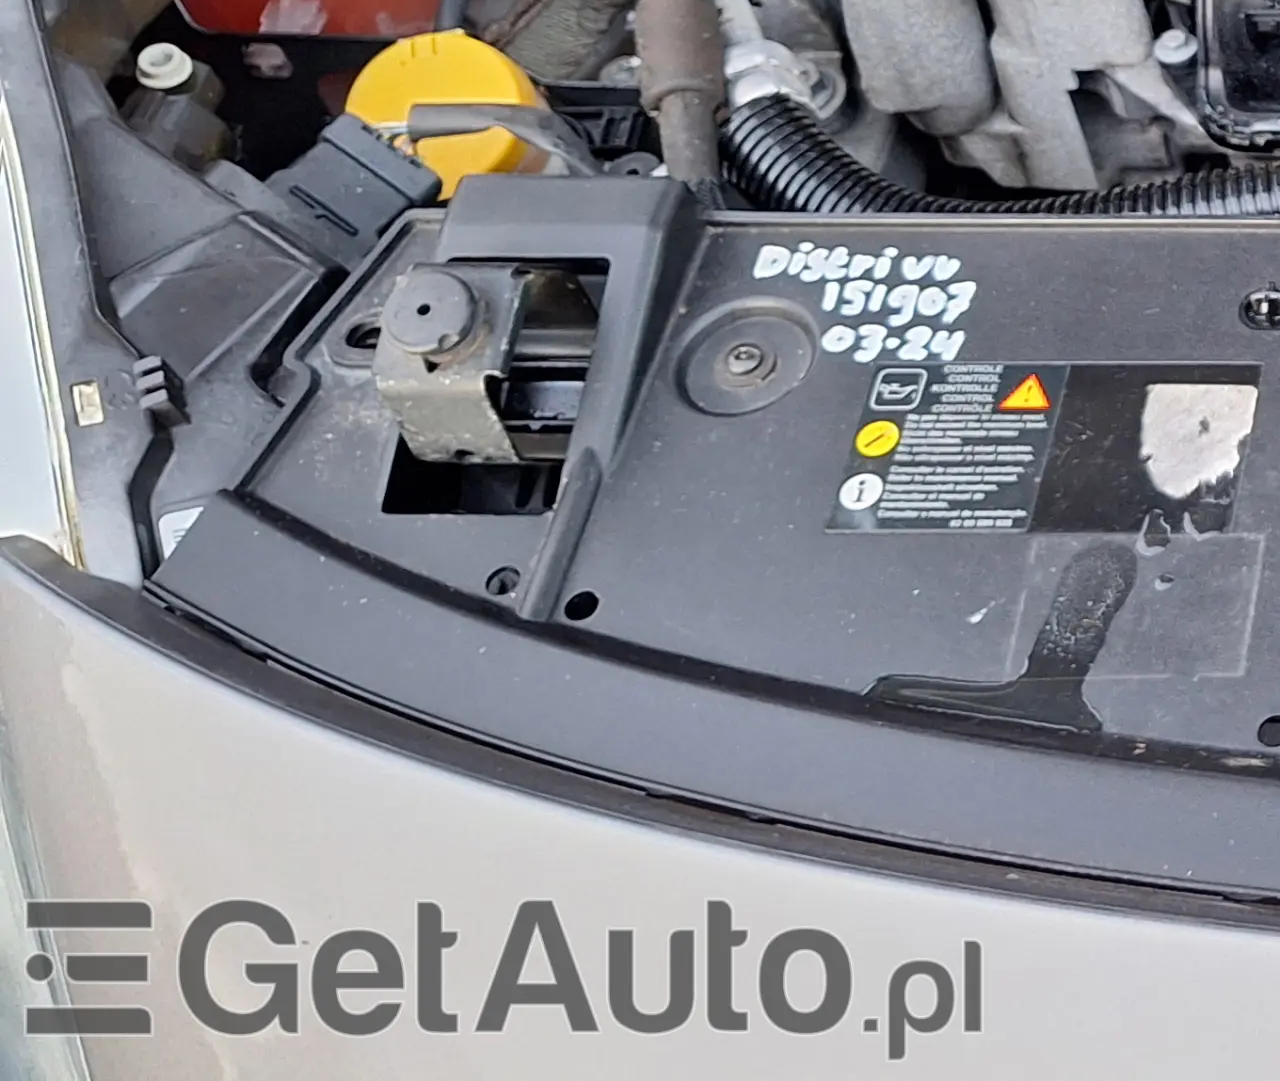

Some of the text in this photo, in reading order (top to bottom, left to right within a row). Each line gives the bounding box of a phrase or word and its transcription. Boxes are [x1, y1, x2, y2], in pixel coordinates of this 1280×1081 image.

[752, 241, 899, 282] Distri
[821, 279, 977, 327] 151907
[930, 383, 999, 393] KONTROLLE
[948, 374, 1001, 383] CONTROL
